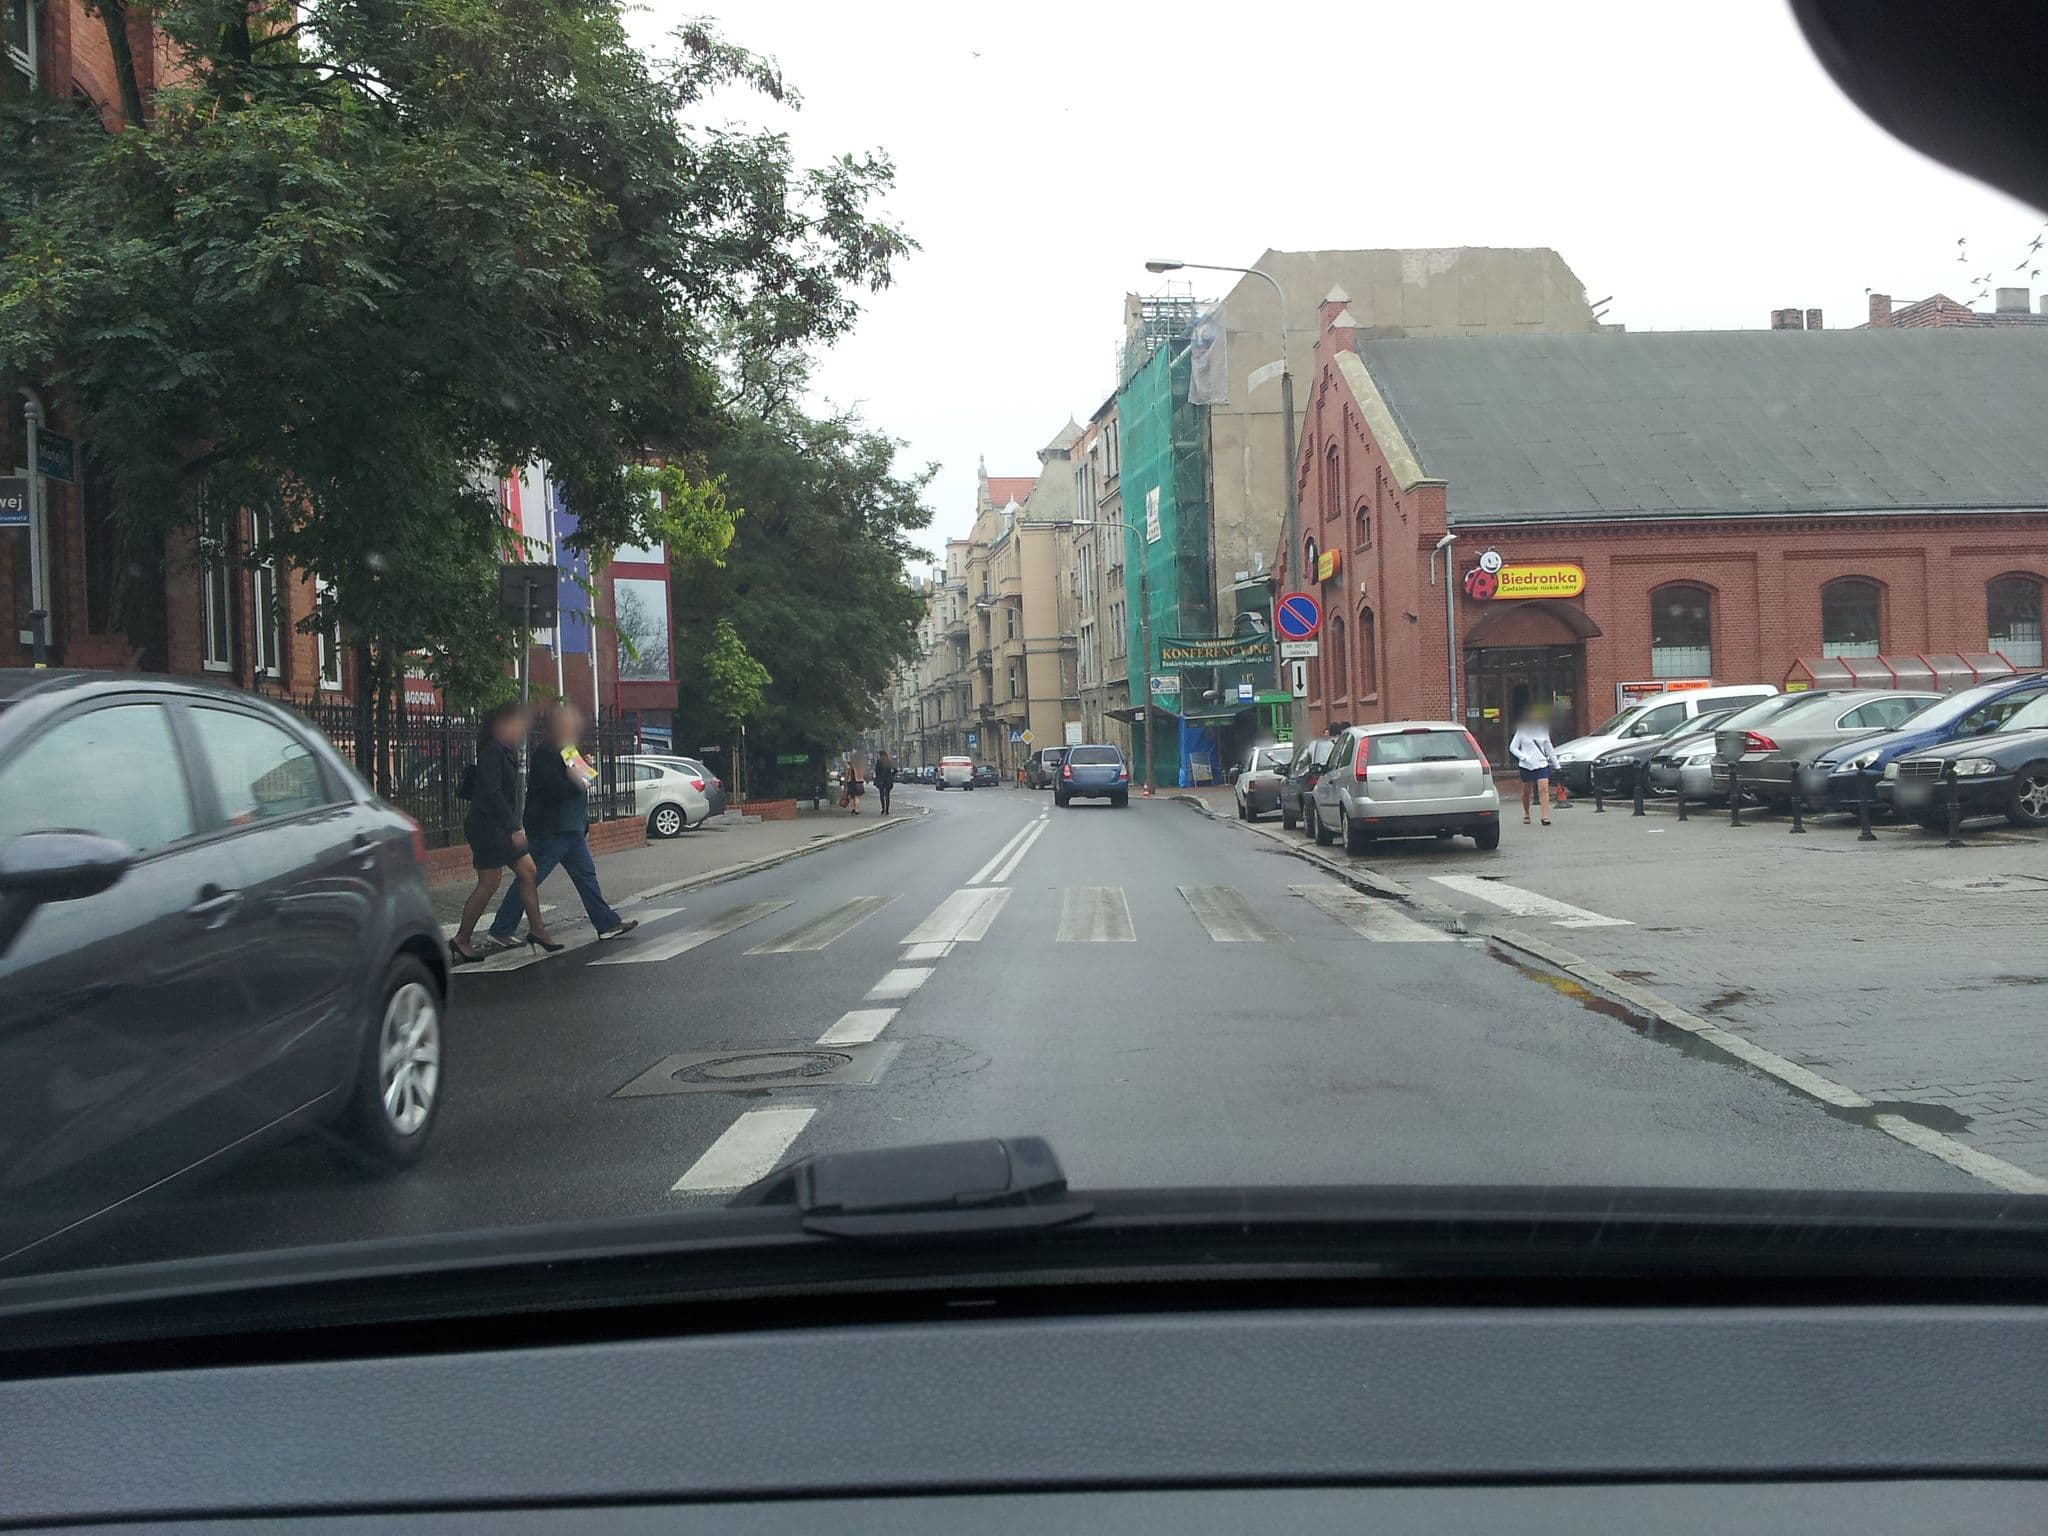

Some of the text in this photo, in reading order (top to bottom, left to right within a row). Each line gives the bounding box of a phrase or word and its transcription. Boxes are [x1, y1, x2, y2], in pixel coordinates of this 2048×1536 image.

[1501, 572, 1577, 585] Biedronka
[1195, 639, 1235, 647] Centrum
[1162, 643, 1270, 660] KONFERENCYJNE
